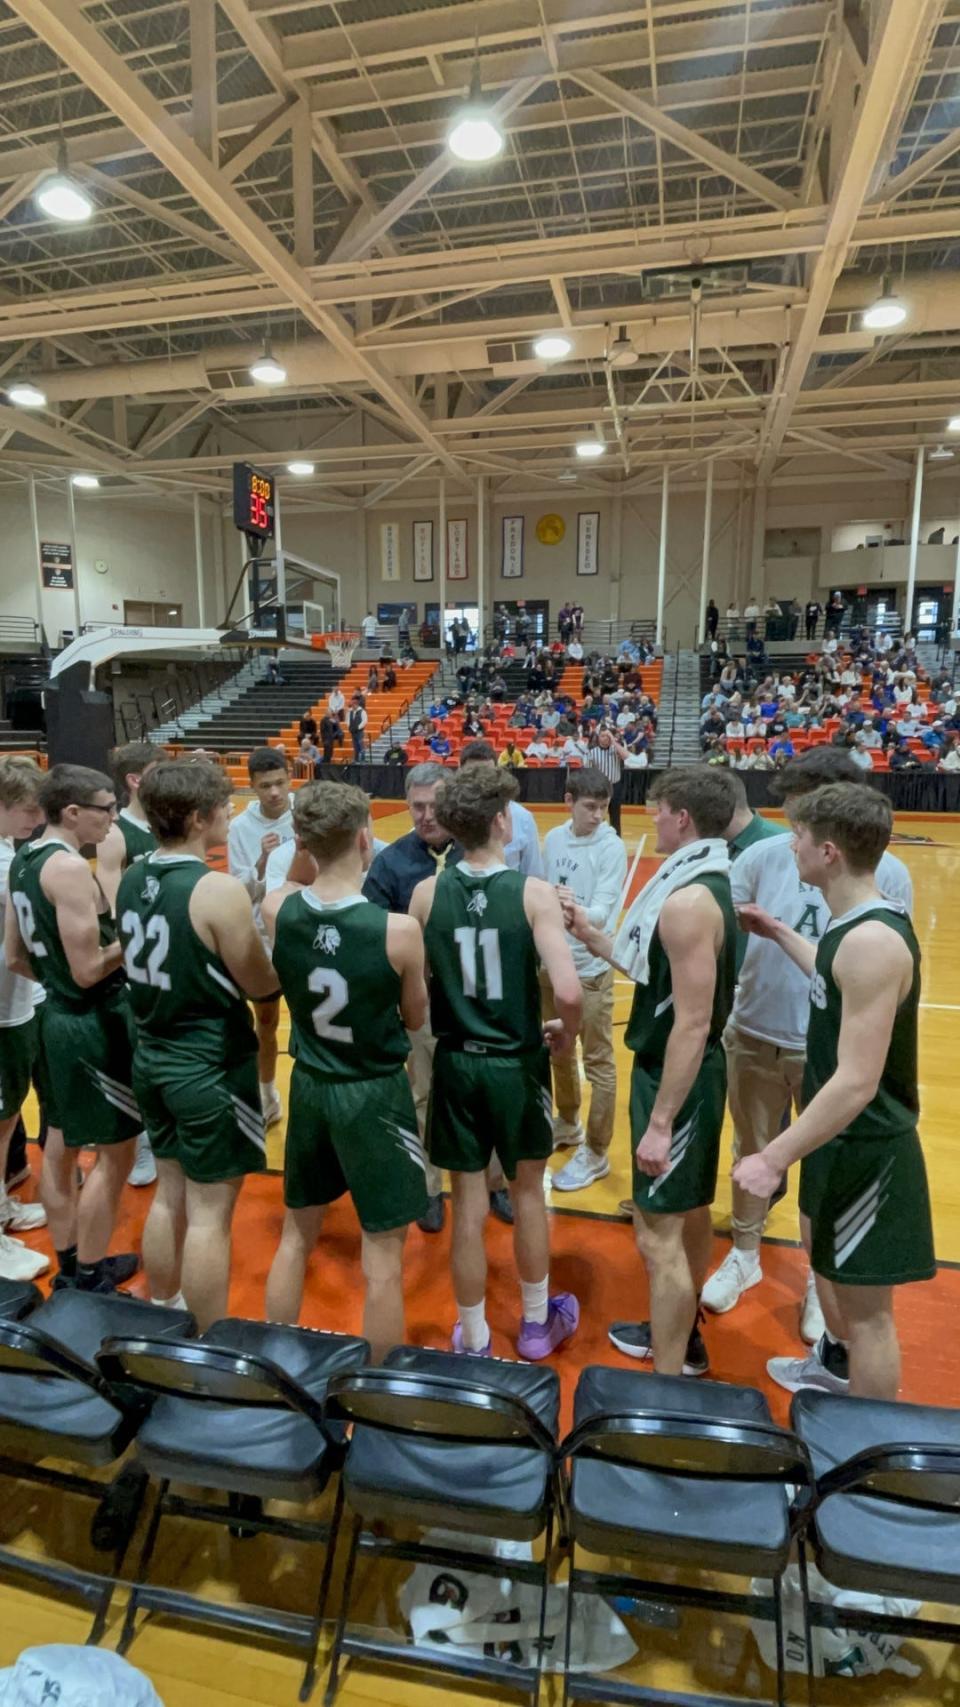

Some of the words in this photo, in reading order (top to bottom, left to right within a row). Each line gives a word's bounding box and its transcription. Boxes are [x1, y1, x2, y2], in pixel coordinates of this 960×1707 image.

[250, 493, 267, 528] 35
[251, 475, 270, 499] 8:00
[793, 904, 819, 937] A
[121, 910, 172, 991] 22
[454, 926, 503, 1000] 11
[308, 967, 353, 1043] 2
